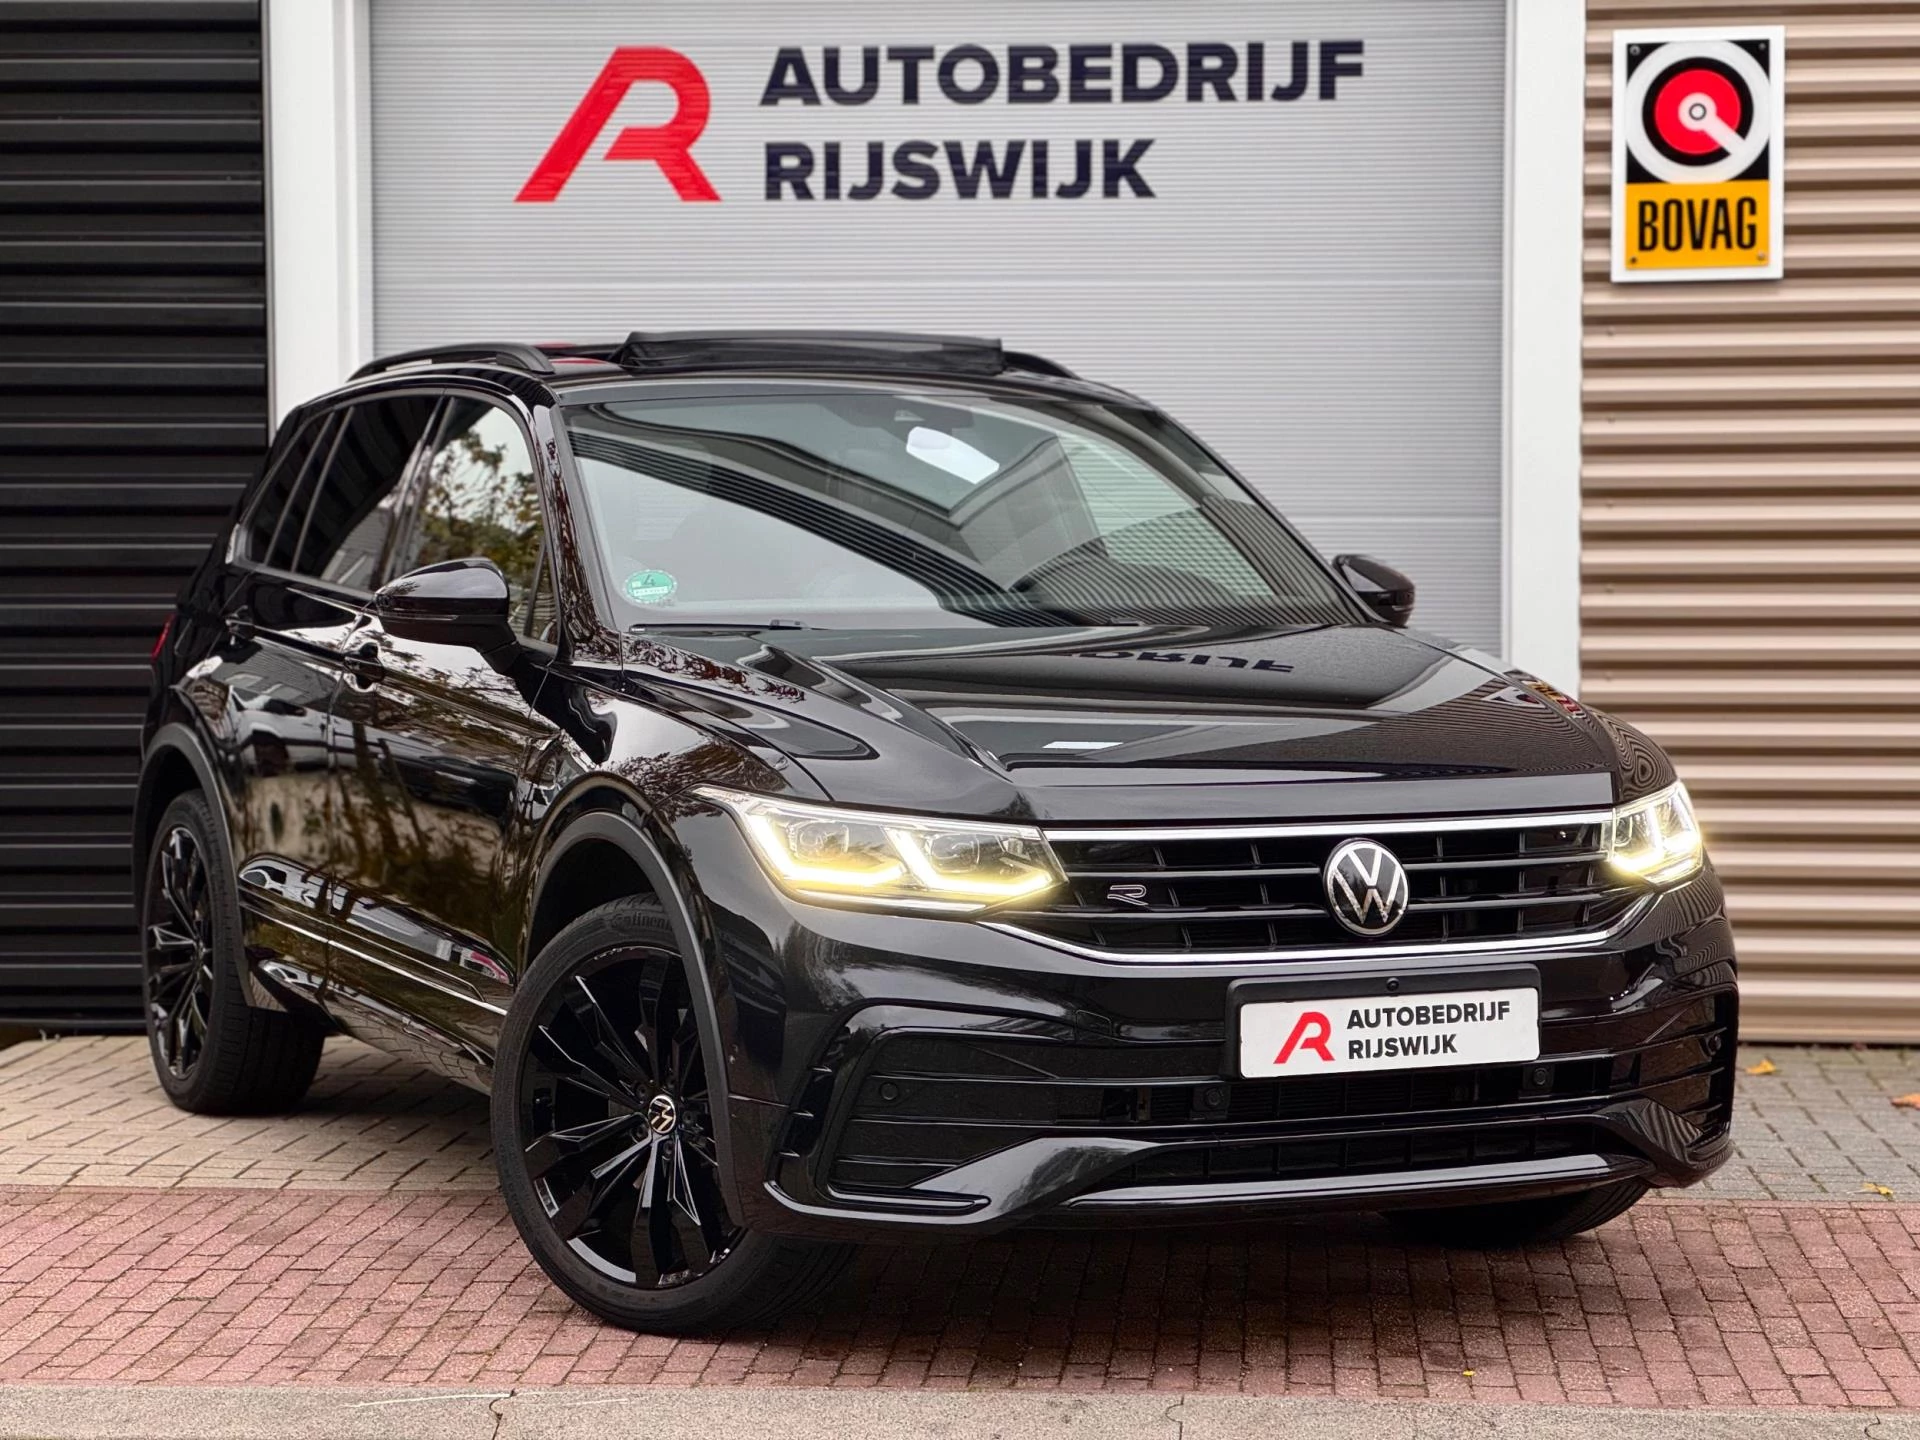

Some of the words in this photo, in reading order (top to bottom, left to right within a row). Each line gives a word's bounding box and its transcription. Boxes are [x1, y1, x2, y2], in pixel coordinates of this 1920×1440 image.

[760, 40, 1364, 106] AUTOBEDRIJF
[765, 139, 1156, 201] RIJSWIJK
[1638, 196, 1757, 252] BOVAG
[1106, 883, 1149, 906] R
[1347, 1001, 1510, 1030] AUTOBEDRIJF
[1348, 1034, 1458, 1060] RIJSWIJK
